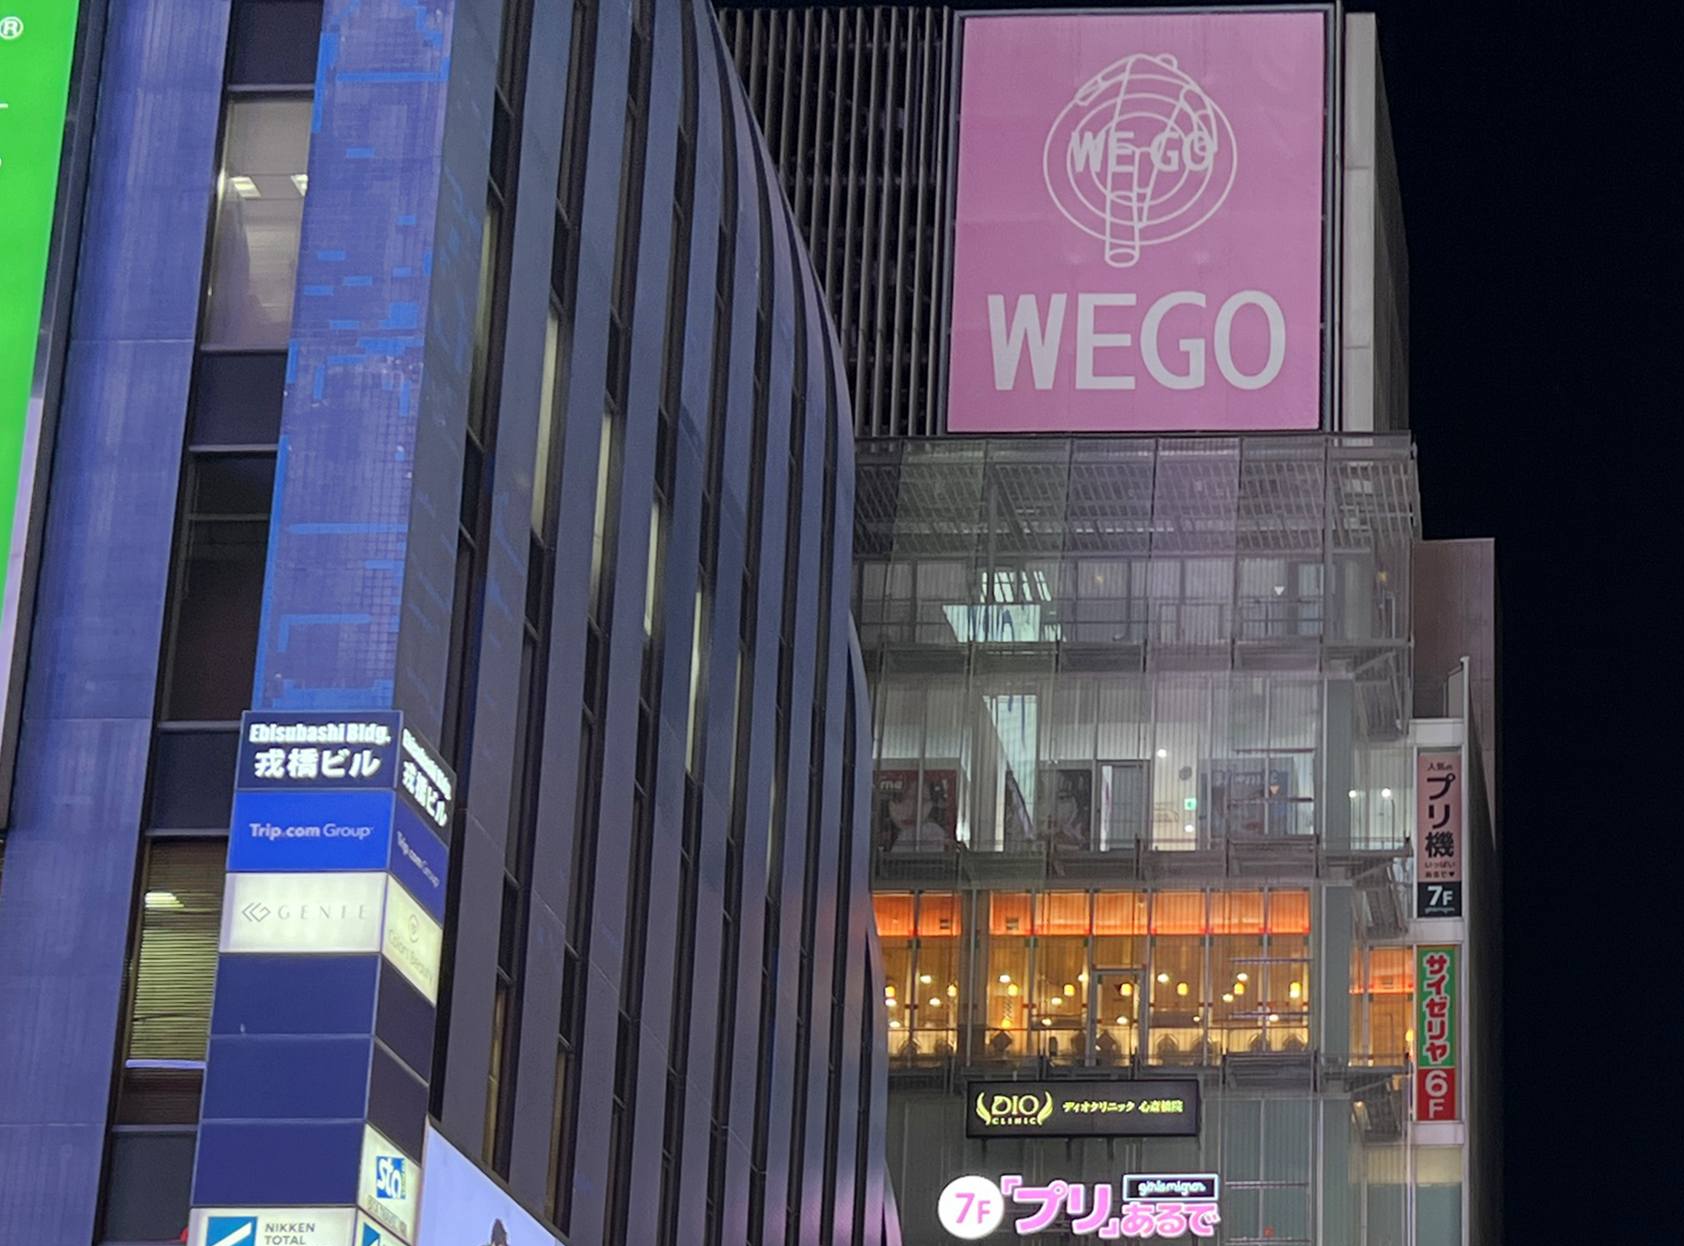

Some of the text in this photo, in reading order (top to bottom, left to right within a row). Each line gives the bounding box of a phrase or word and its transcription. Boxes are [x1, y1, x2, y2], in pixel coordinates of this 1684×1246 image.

[987, 290, 1287, 391] WEGO
[249, 723, 347, 742] Ebisubashi
[254, 749, 381, 779] 戎橋ビル
[1424, 773, 1456, 859] プリ機
[249, 823, 372, 840] Trip.com Group
[1427, 885, 1454, 907] 7F
[277, 904, 369, 921] GENIE
[1424, 954, 1448, 1063] サイゼリヤ
[991, 1095, 1039, 1116] DIO
[991, 1116, 1038, 1126] CLINIC
[954, 1192, 992, 1224] 7F
[265, 1223, 316, 1233] NIKKEN
[264, 1235, 307, 1246] TOTAL
